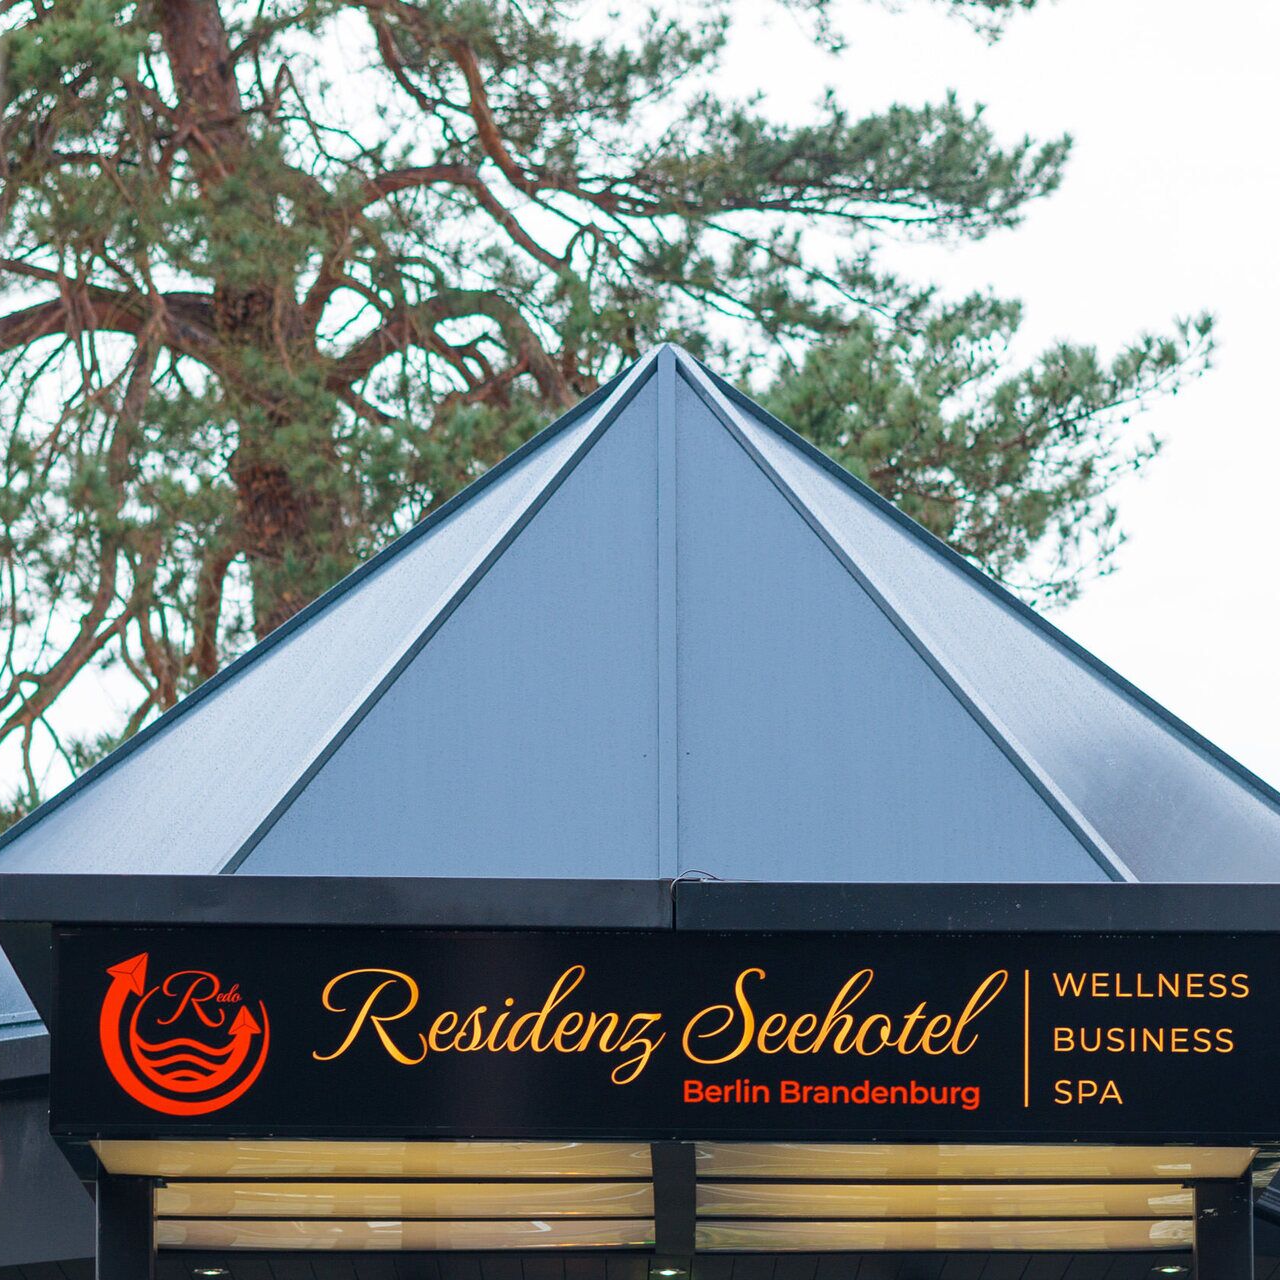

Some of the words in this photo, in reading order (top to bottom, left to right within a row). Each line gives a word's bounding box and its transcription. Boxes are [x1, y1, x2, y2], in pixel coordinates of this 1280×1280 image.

[156, 970, 242, 1028] Redo
[1052, 972, 1250, 999] WELLNESS
[312, 964, 667, 1086] Residenz
[681, 967, 1009, 1065] Seehotel
[1053, 1027, 1235, 1054] BUSINESS
[683, 1078, 771, 1104] Berlin
[779, 1079, 981, 1111] Brandenburg
[1053, 1079, 1124, 1105] SPA
